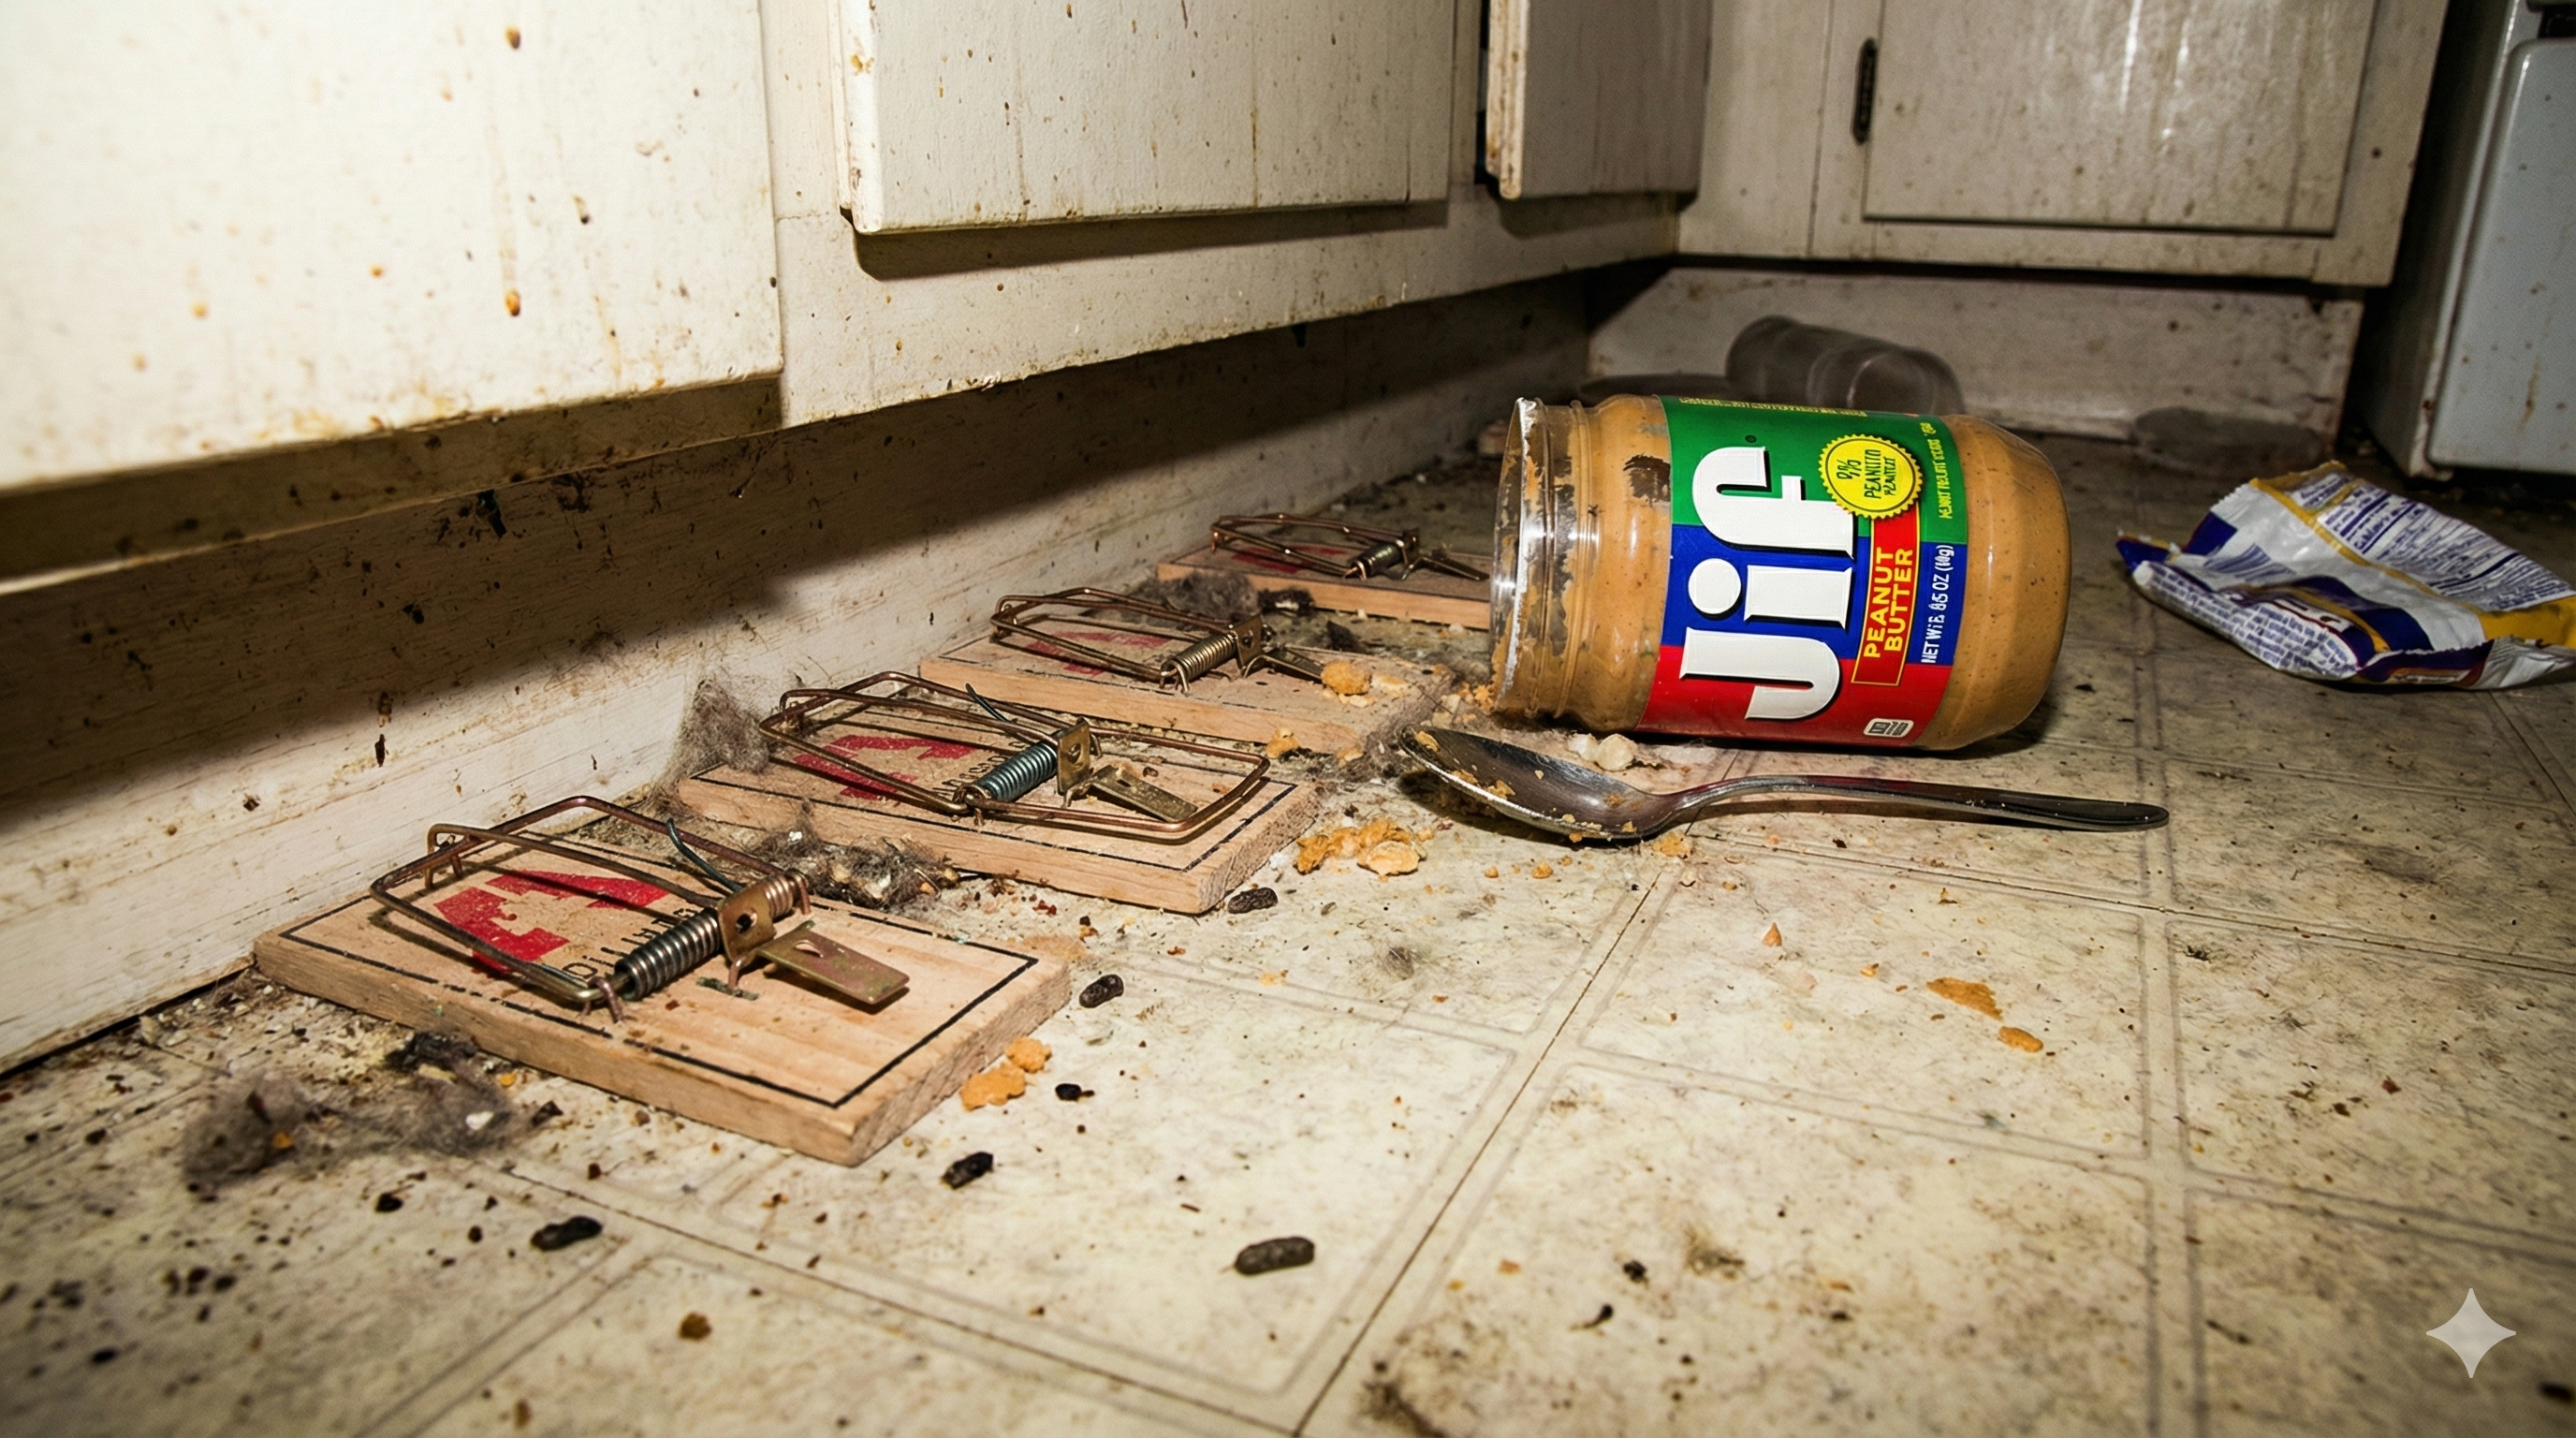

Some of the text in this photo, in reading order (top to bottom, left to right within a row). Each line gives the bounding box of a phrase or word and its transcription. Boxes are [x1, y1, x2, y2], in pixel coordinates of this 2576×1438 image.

[1679, 446, 1854, 721] Jif
[1864, 547, 1894, 658] PEANUT
[1884, 549, 1913, 652] BUTTER
[1921, 641, 1940, 664] NET
[1932, 574, 1950, 591] OZ
